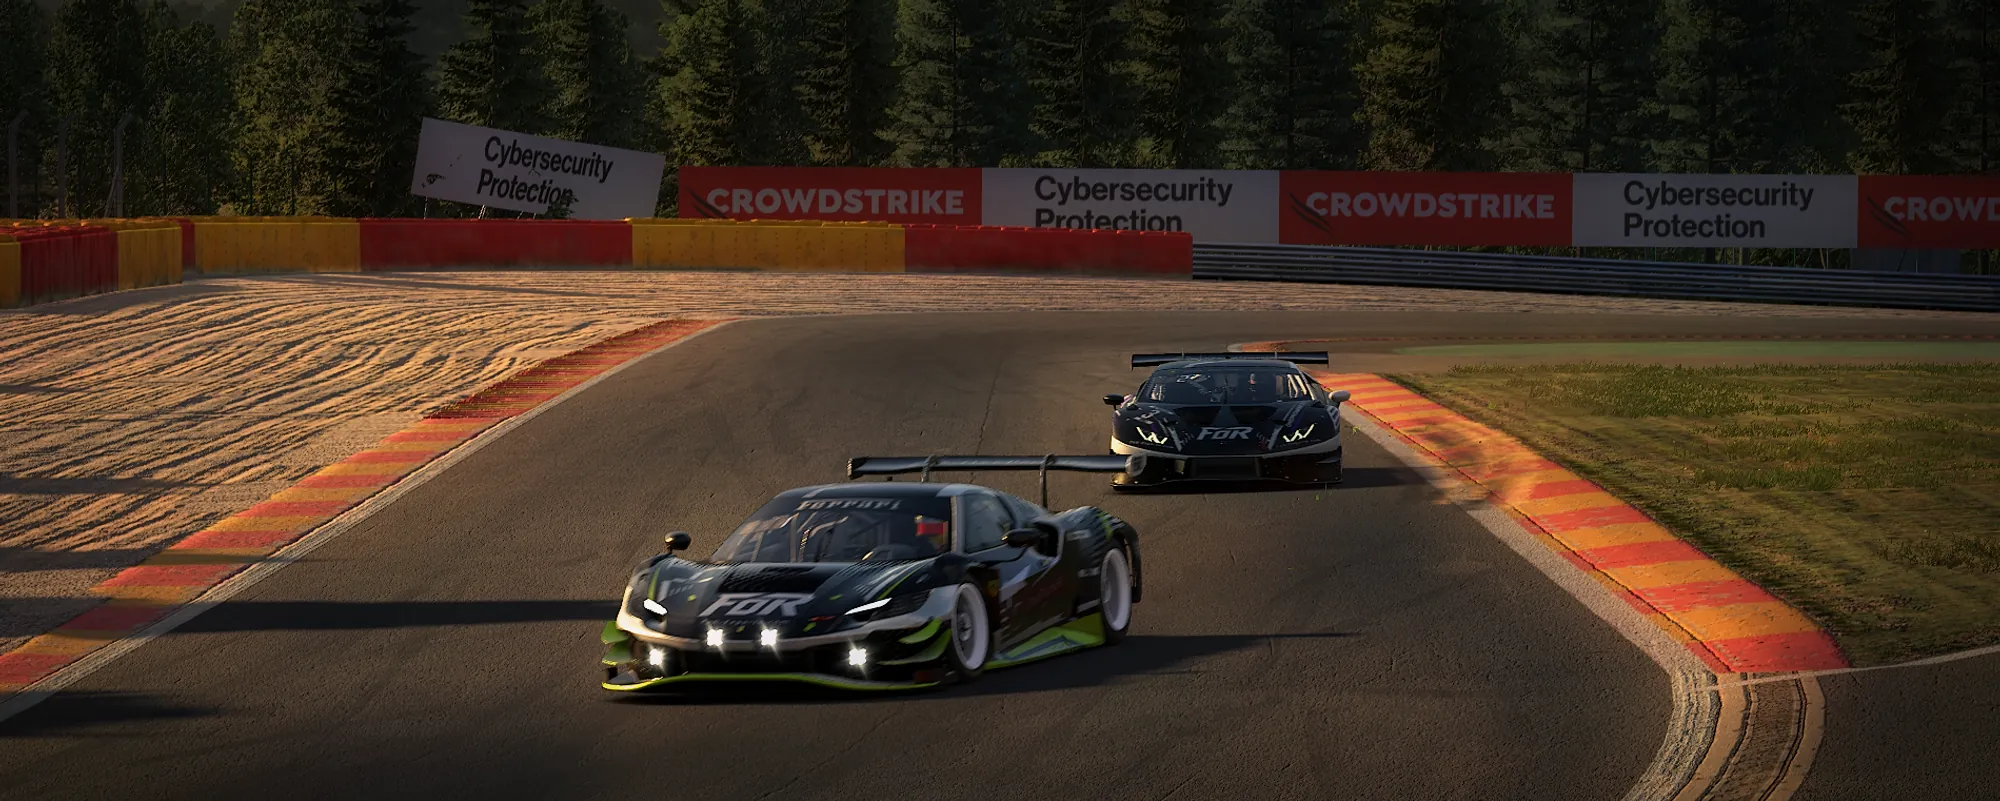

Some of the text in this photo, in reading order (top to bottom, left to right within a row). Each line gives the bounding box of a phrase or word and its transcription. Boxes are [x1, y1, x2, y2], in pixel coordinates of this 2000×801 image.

[484, 135, 614, 184] Cybersecurity
[706, 187, 965, 216] CROWDSTRIKE
[1034, 175, 1234, 207] Cybersecurity
[1305, 191, 1556, 220] CROWDSTRIKE
[1623, 180, 1815, 212] Cybersecurity
[1035, 208, 1182, 231] Protection
[1623, 212, 1766, 238] Protection
